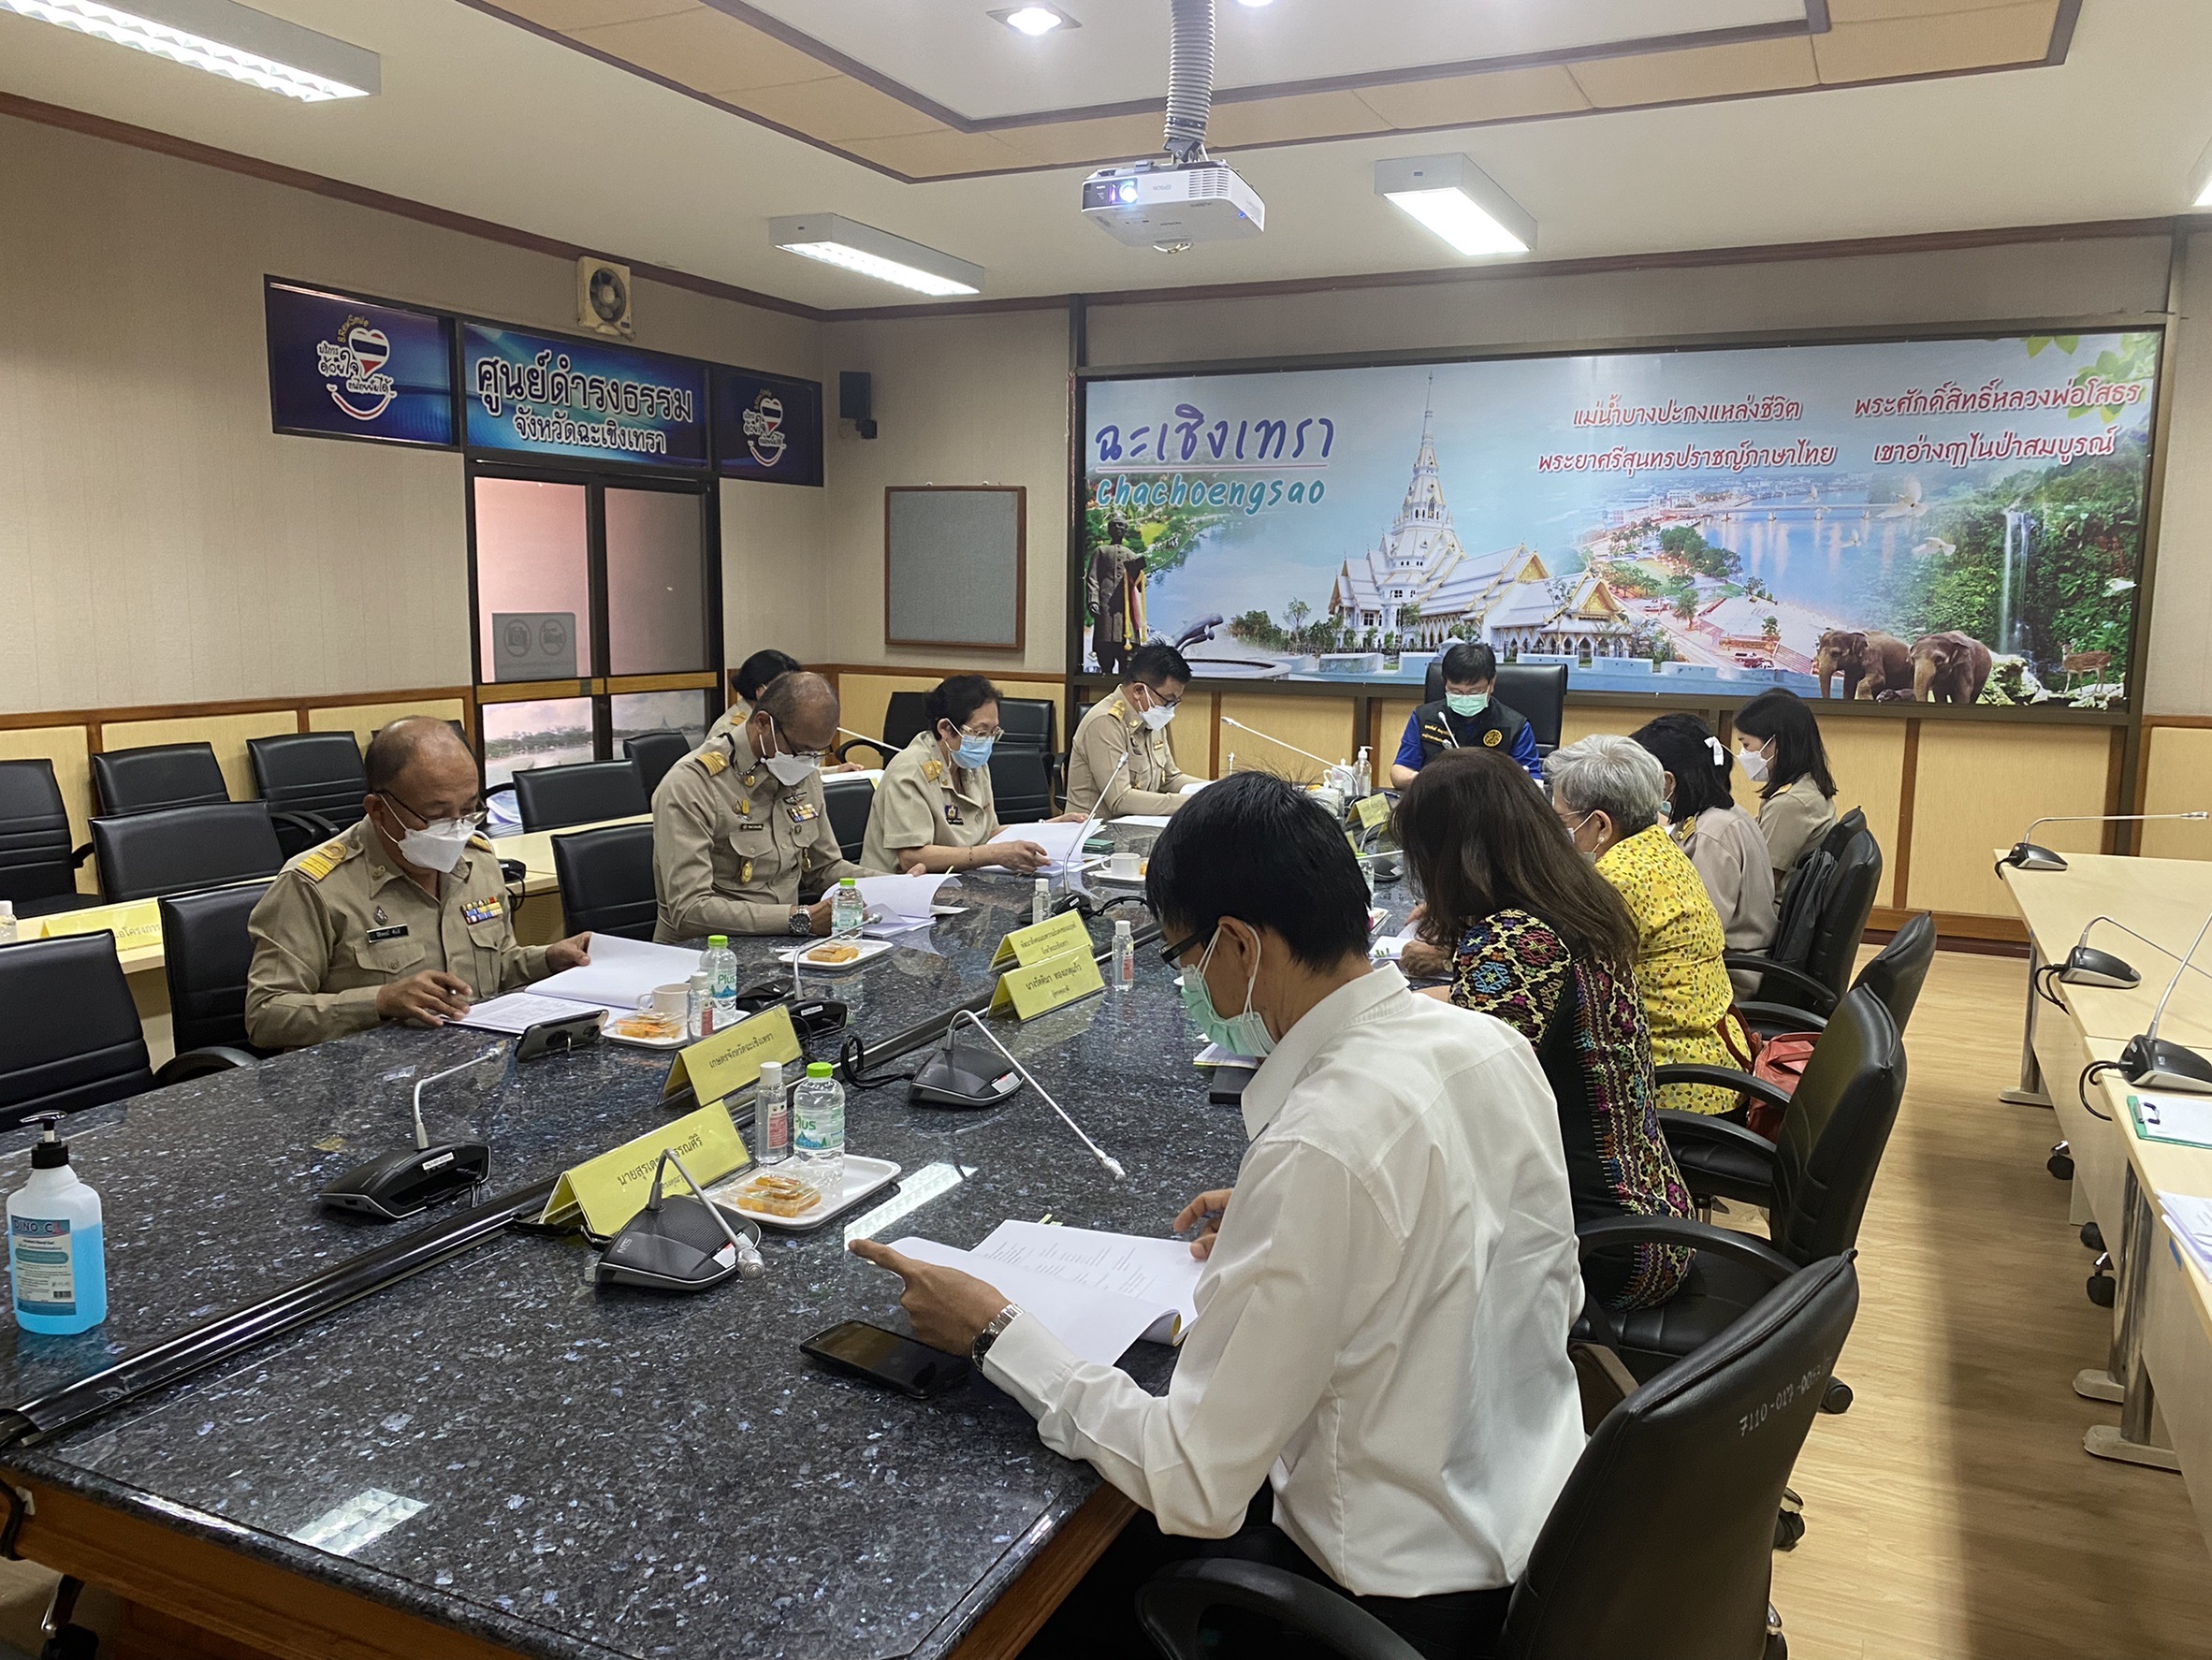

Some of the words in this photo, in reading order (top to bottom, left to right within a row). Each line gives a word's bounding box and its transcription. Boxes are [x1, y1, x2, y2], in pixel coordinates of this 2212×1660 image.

[318, 342, 339, 356] บริการ
[320, 349, 359, 376] ด้วยใจ
[476, 350, 692, 422] ศูนย์ดำรงธรรม
[1572, 393, 1804, 429] แม่น้ำบางปะกงแหล่งชีวิต
[1854, 377, 2144, 417] พระศักดิ์สิทธิ์หลวงพ่อโสธร
[514, 405, 667, 455] จังหวัดฉะเชิงเทรา
[1095, 403, 1334, 461] ฉะเชิงเทรา
[1537, 438, 1839, 477] พระยาศรีสุนทรปราชญ์ภาษาไทย
[1873, 424, 2119, 468] เขาอ่างฤๅไนป่าสมบูรณ์
[718, 973, 735, 984] Plus
[617, 1157, 661, 1186] นายสุรเด
